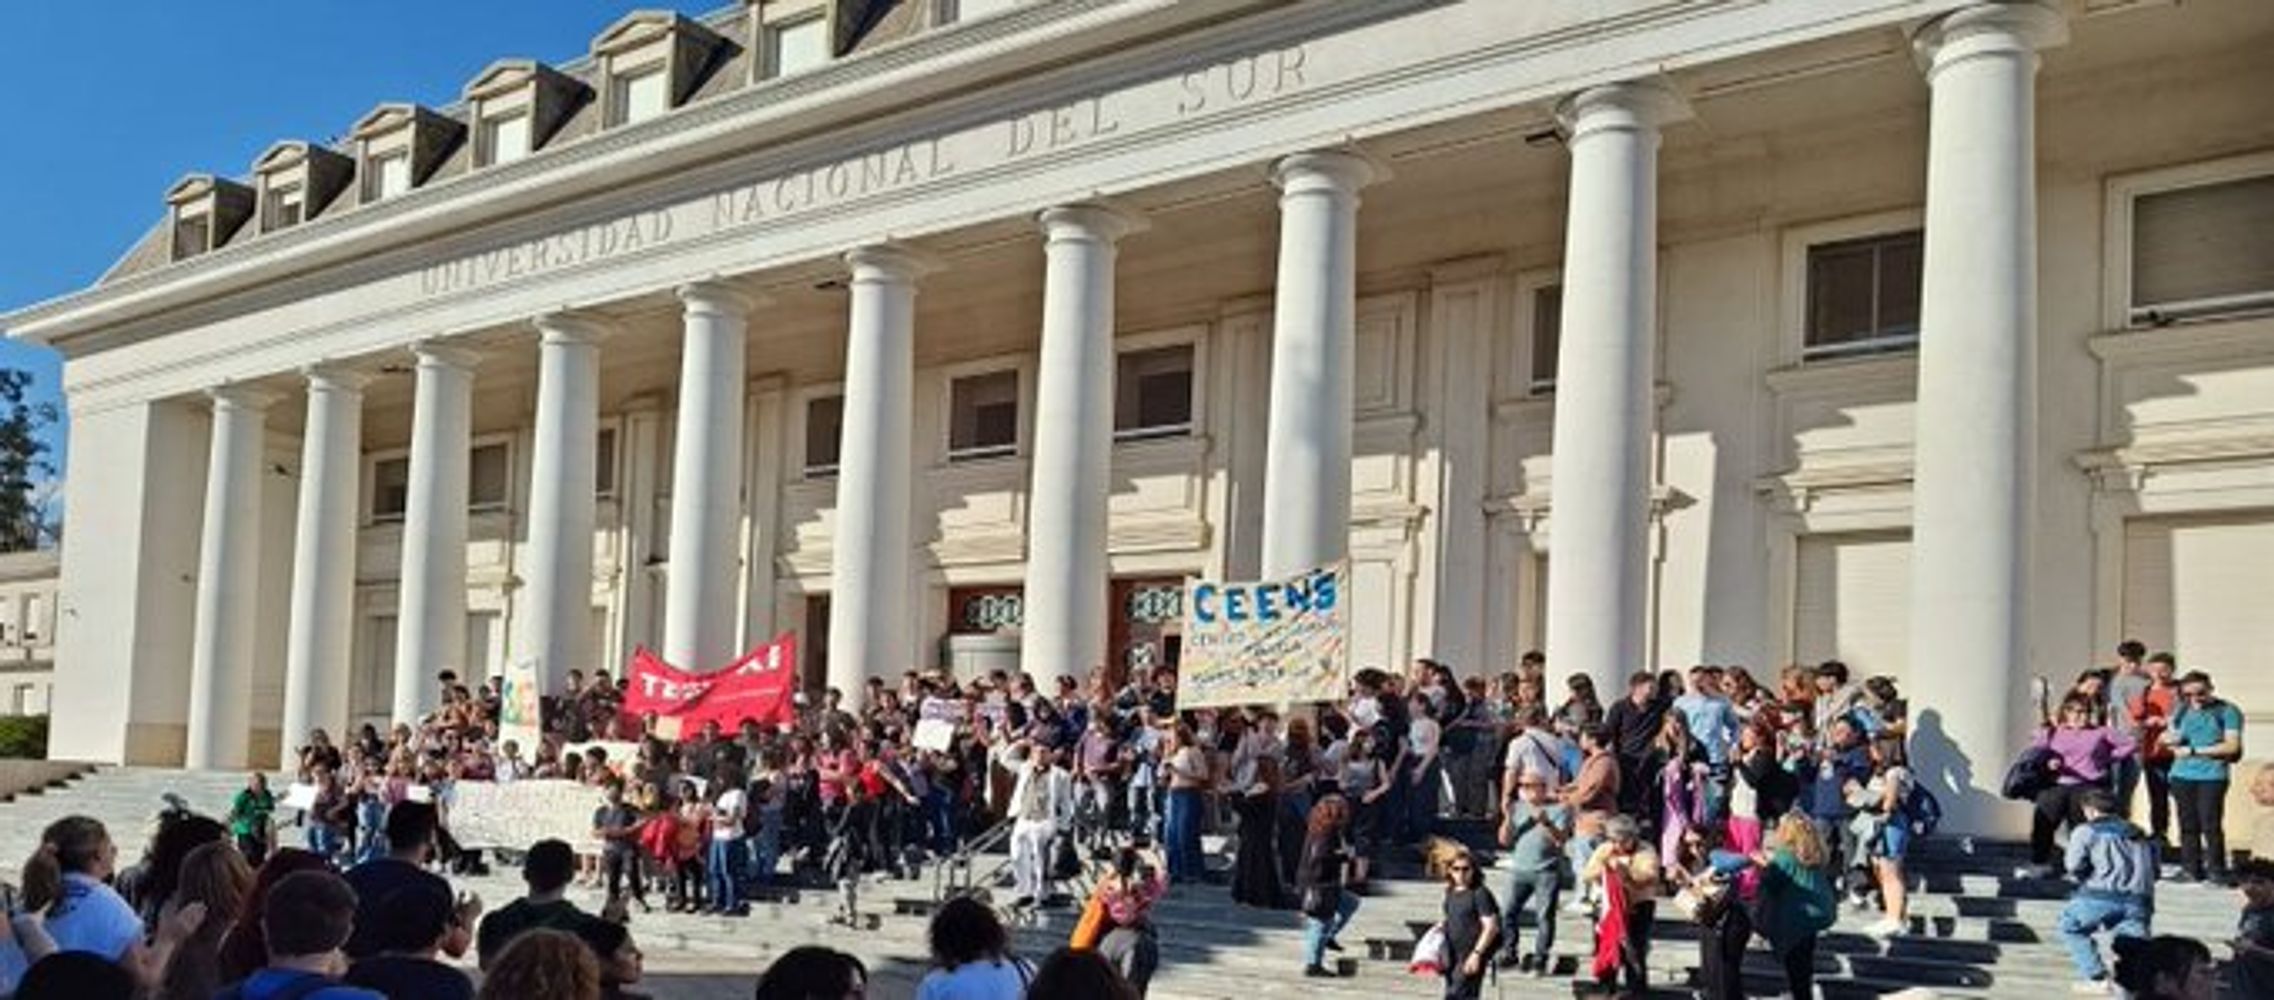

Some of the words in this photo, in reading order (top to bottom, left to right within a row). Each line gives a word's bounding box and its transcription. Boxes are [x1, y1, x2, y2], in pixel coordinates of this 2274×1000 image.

[420, 210, 674, 295] UNIVERSIDAD
[712, 138, 955, 227] NACIONAL
[1009, 96, 1119, 156] DEL
[1177, 49, 1306, 115] SUR
[1194, 572, 1336, 622] CEENS
